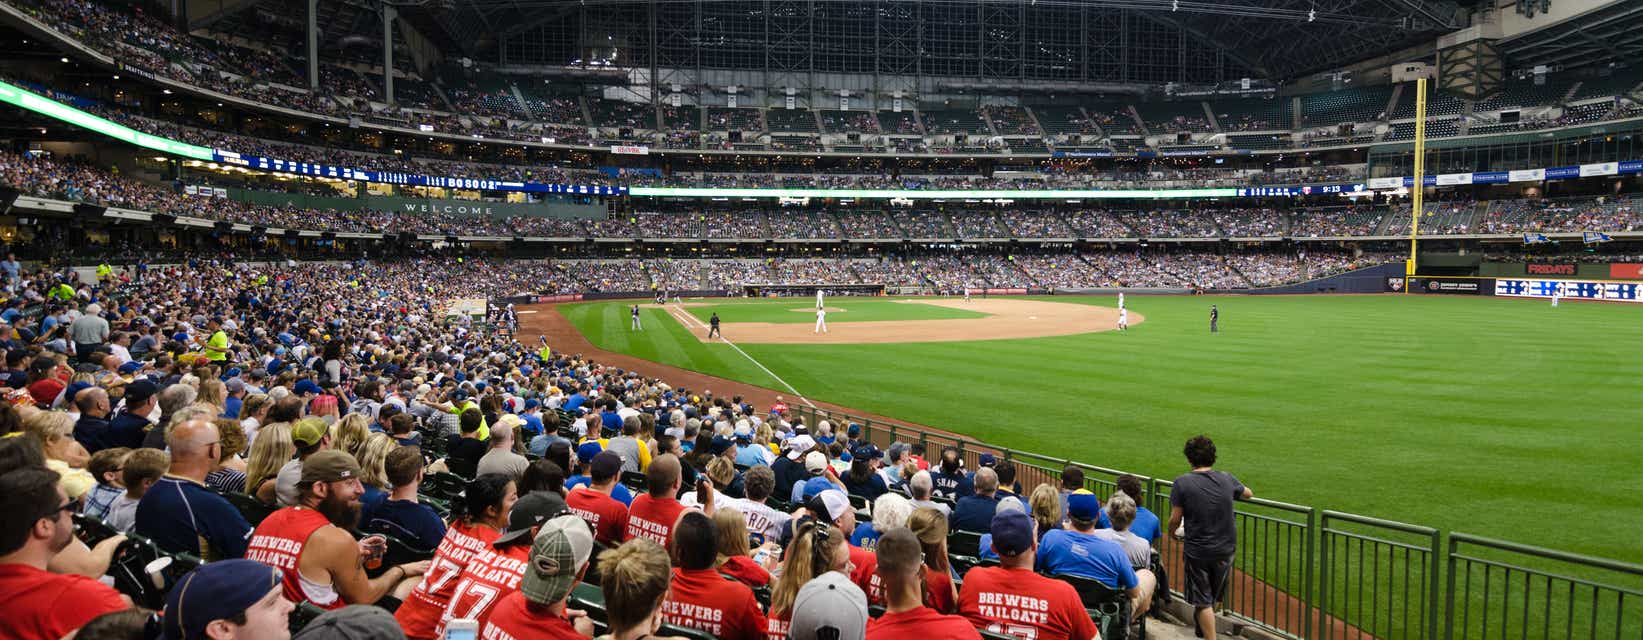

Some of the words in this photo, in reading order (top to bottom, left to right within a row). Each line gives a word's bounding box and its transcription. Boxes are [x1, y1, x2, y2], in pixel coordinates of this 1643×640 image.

[405, 203, 493, 215] WELCOME
[1528, 264, 1575, 275] FRIDAYS
[629, 514, 668, 536] BREWERS
[743, 511, 775, 531] ROY
[250, 535, 302, 555] BREWERS
[247, 549, 297, 569] TAILGATE
[442, 577, 501, 621] 17
[978, 592, 1049, 611] BREWERS
[663, 601, 723, 622] REWERS
[978, 605, 1049, 624] TAILGATE
